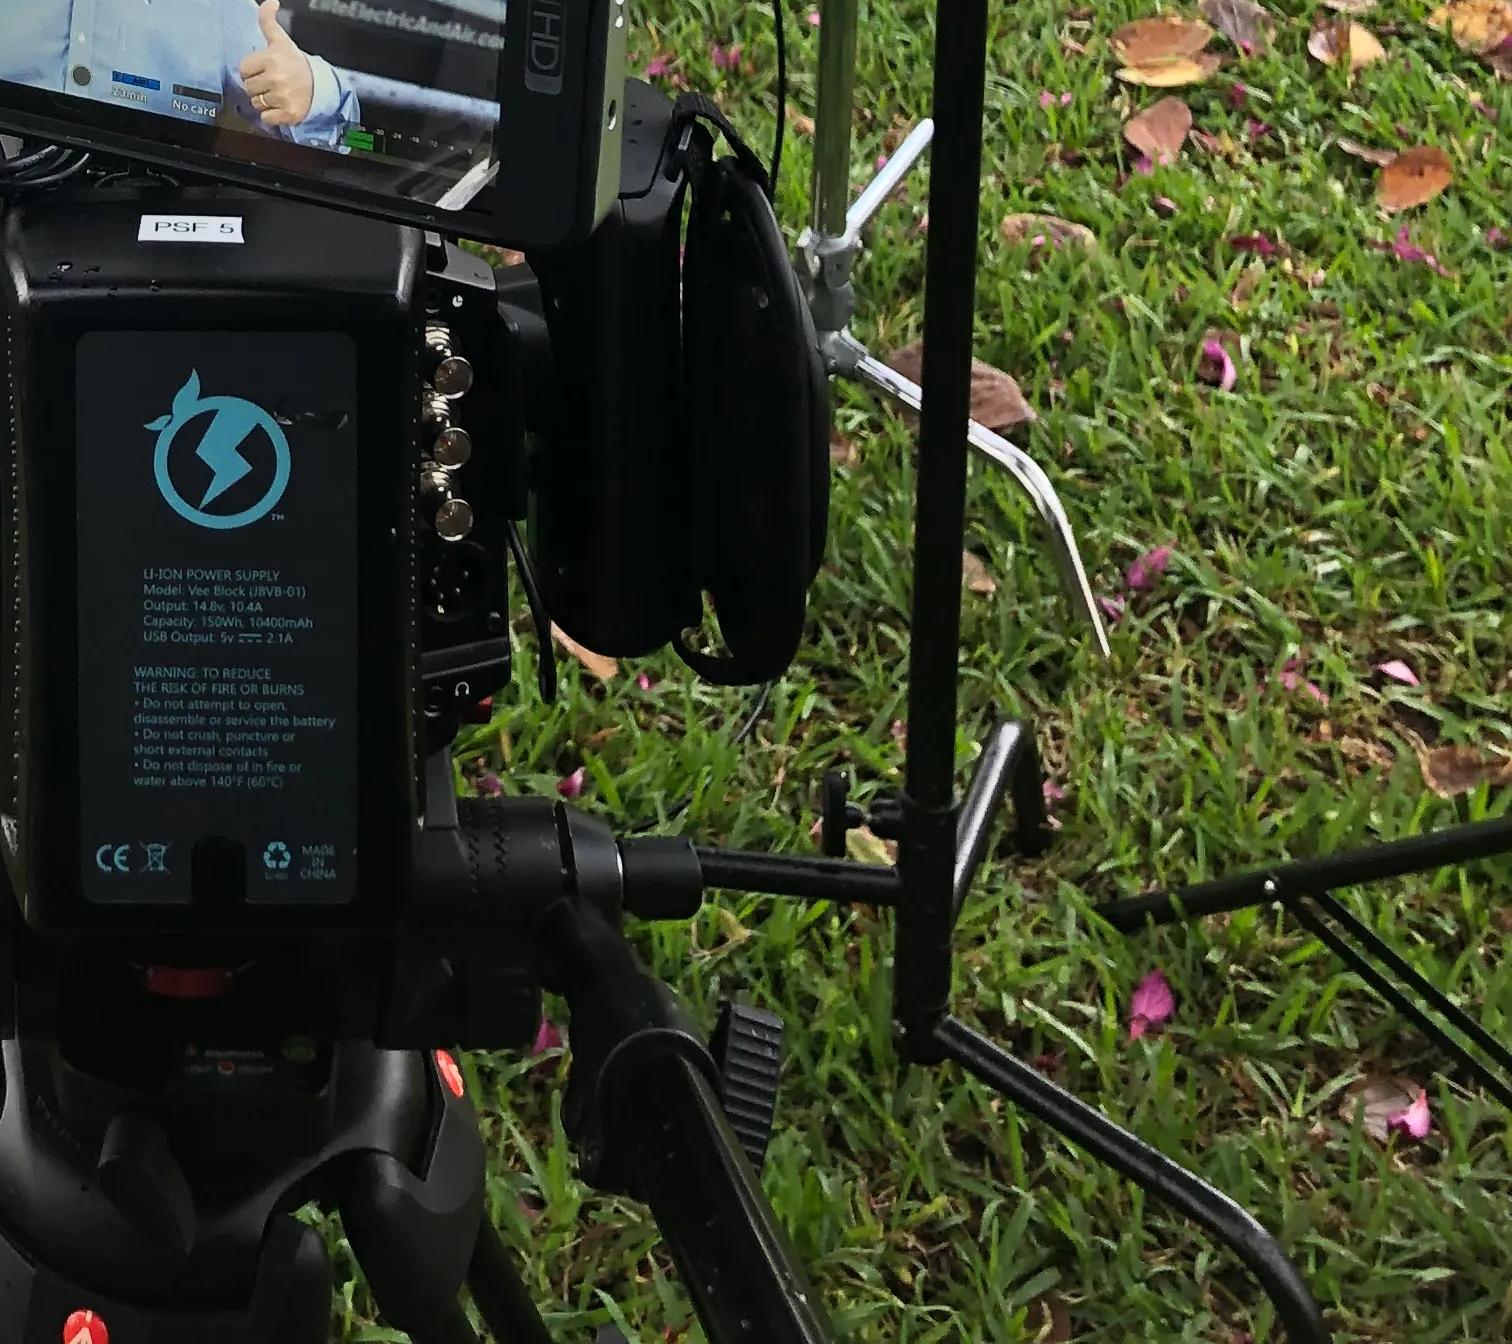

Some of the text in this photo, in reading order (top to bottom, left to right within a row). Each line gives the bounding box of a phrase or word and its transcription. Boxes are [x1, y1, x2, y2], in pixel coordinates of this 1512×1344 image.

[172, 100, 216, 118] No card
[154, 221, 235, 234] PSF 5
[143, 568, 281, 582] LI-ION POWER SUPPLY
[143, 584, 184, 597] Model:
[188, 585, 210, 596] Vee
[213, 585, 246, 597] Block
[143, 599, 189, 613] Output:
[230, 601, 264, 612] 10.4A
[143, 615, 197, 629] Capacity:
[249, 617, 314, 629] 10400mAh
[143, 631, 294, 645] USB Output: 5v 2.1A
[202, 667, 220, 679] TO
[222, 668, 272, 680] REDUCE
[133, 681, 305, 696] THE RISK OF FIRE OR BURNS
[143, 698, 161, 709] Do
[164, 698, 185, 710] not
[188, 699, 234, 712] attempt
[238, 699, 251, 710] to
[133, 713, 336, 730] disassemble or service the battery
[143, 728, 161, 740] Do
[164, 729, 184, 740] not
[225, 732, 279, 744] puncture
[282, 733, 296, 742] or
[133, 743, 269, 758] short external contacts
[143, 759, 302, 774] Do not dispose of in fire or
[133, 775, 284, 790] water above 140°F (60°C)
[96, 844, 130, 872] CE
[301, 845, 335, 857] MADE
[311, 858, 326, 869] IN
[300, 867, 337, 881] CHINA
